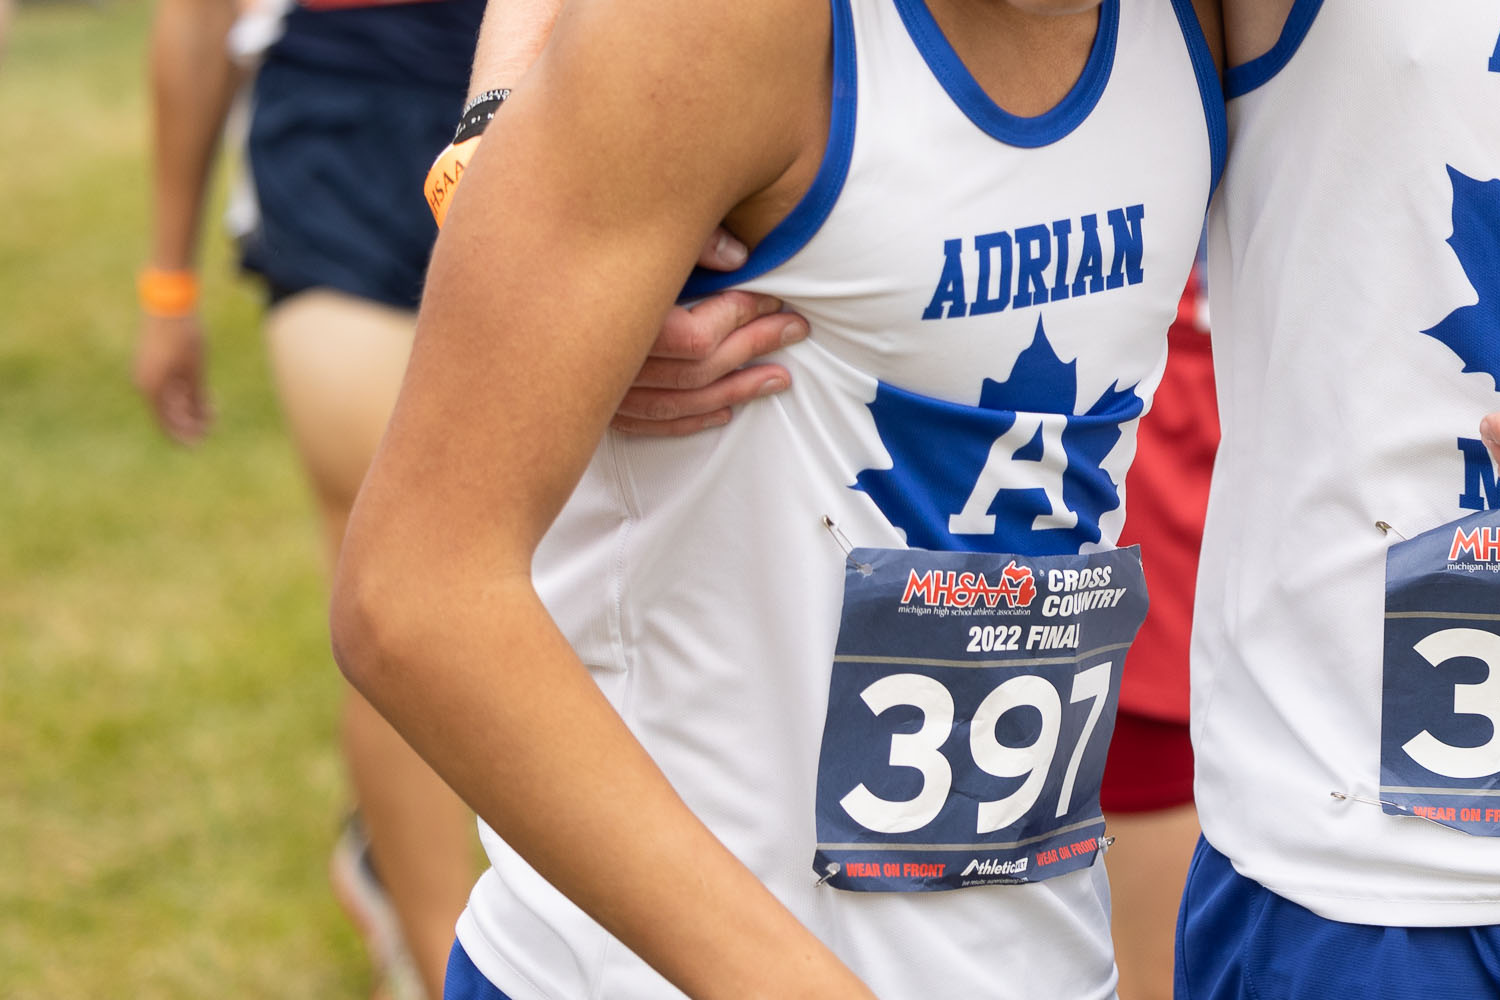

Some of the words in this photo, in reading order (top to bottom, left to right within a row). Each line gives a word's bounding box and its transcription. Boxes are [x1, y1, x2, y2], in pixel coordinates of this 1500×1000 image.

[430, 160, 464, 219] HSAA
[921, 203, 1145, 321] ADRIAN
[949, 411, 1078, 535] A
[1048, 565, 1112, 593] CROSS
[1447, 562, 1483, 572] michigan
[901, 567, 1018, 609] MHSAA
[1041, 587, 1127, 618] COUNTRY
[898, 605, 931, 616] michigan
[933, 606, 949, 617] high
[951, 607, 972, 616] school
[973, 607, 995, 616] athletic
[997, 607, 1031, 616] association
[966, 625, 1022, 652] 2022
[1025, 623, 1080, 650] FINAL
[839, 661, 1112, 834] 397
[1413, 805, 1456, 821] WEAR
[1460, 808, 1481, 822] ON
[1036, 849, 1059, 867] WEAR
[1059, 846, 1072, 860] ON
[1070, 838, 1098, 856] FRONT
[846, 863, 881, 878] WEAR
[884, 863, 900, 877] ON
[904, 863, 946, 878] FRONT
